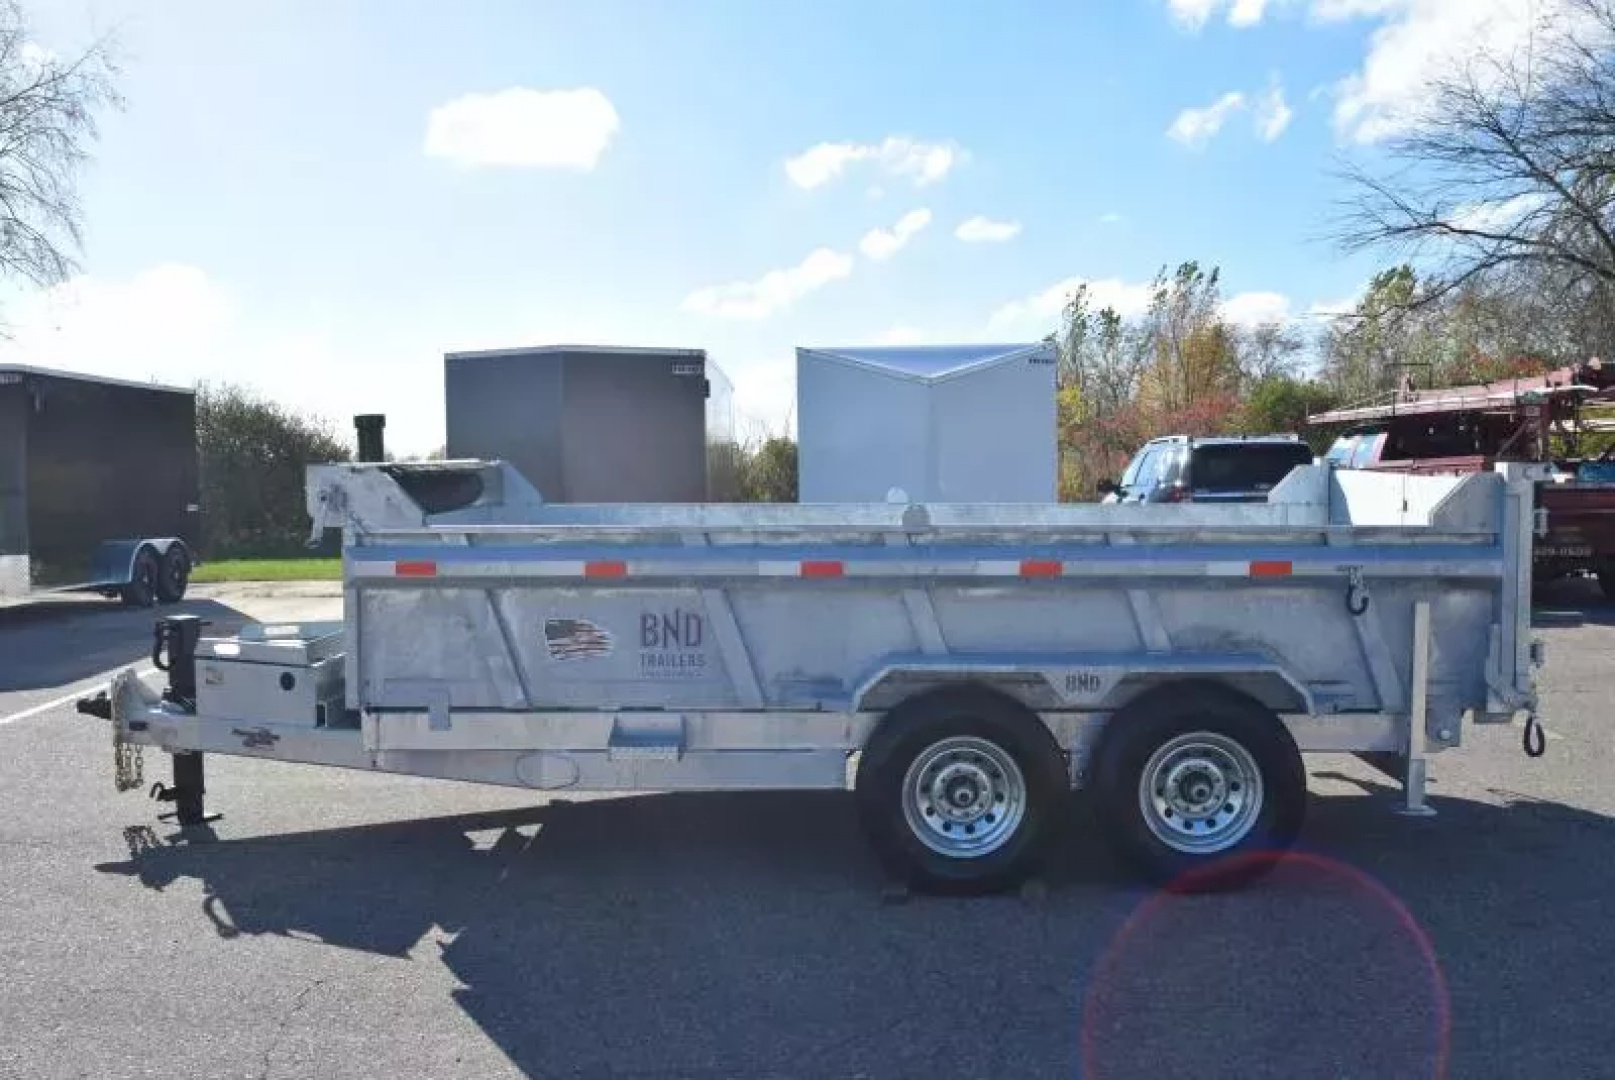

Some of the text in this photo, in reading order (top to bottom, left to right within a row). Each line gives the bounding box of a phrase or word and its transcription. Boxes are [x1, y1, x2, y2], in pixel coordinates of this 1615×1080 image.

[641, 608, 702, 648] BND
[640, 653, 706, 667] TRAILERS
[1065, 673, 1100, 692] BND
